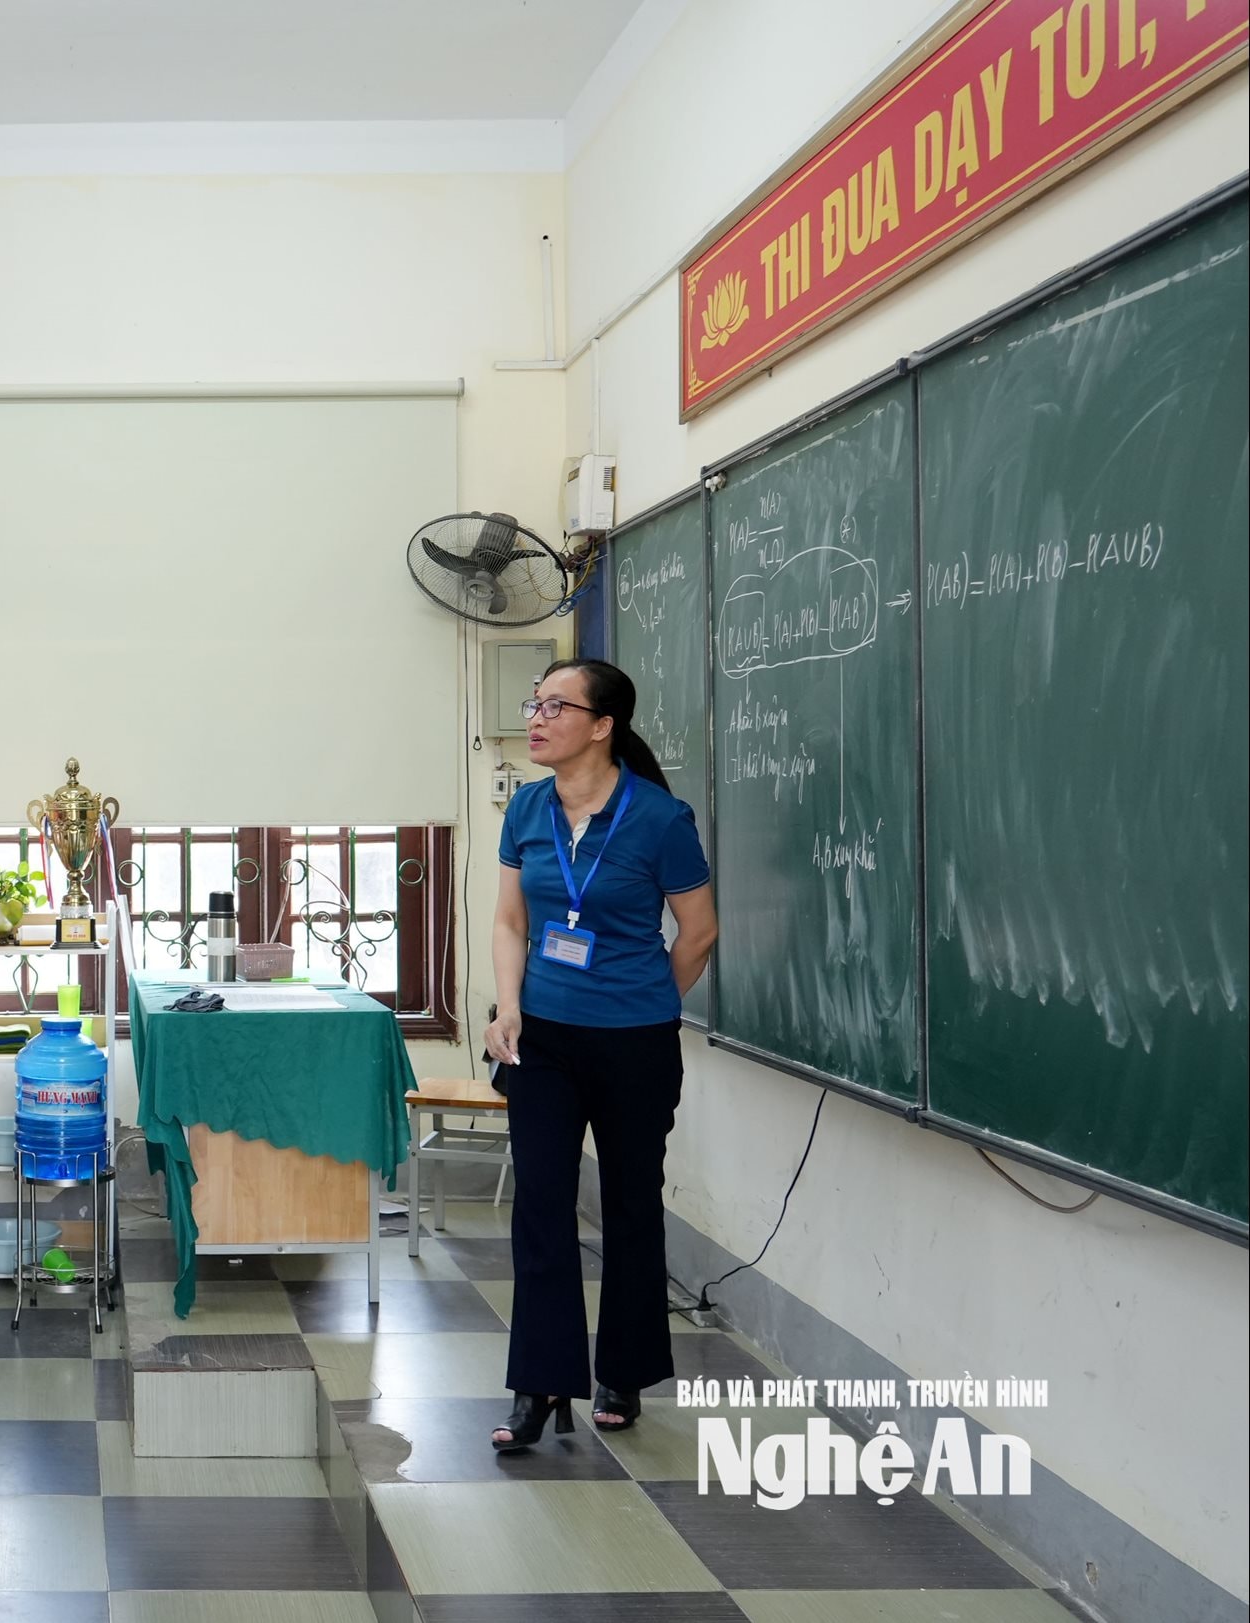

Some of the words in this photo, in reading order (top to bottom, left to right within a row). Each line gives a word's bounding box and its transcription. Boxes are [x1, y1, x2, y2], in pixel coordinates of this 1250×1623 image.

[760, 211, 810, 321] THI
[821, 145, 900, 278] ĐUA
[914, 47, 1013, 214] DẠY
